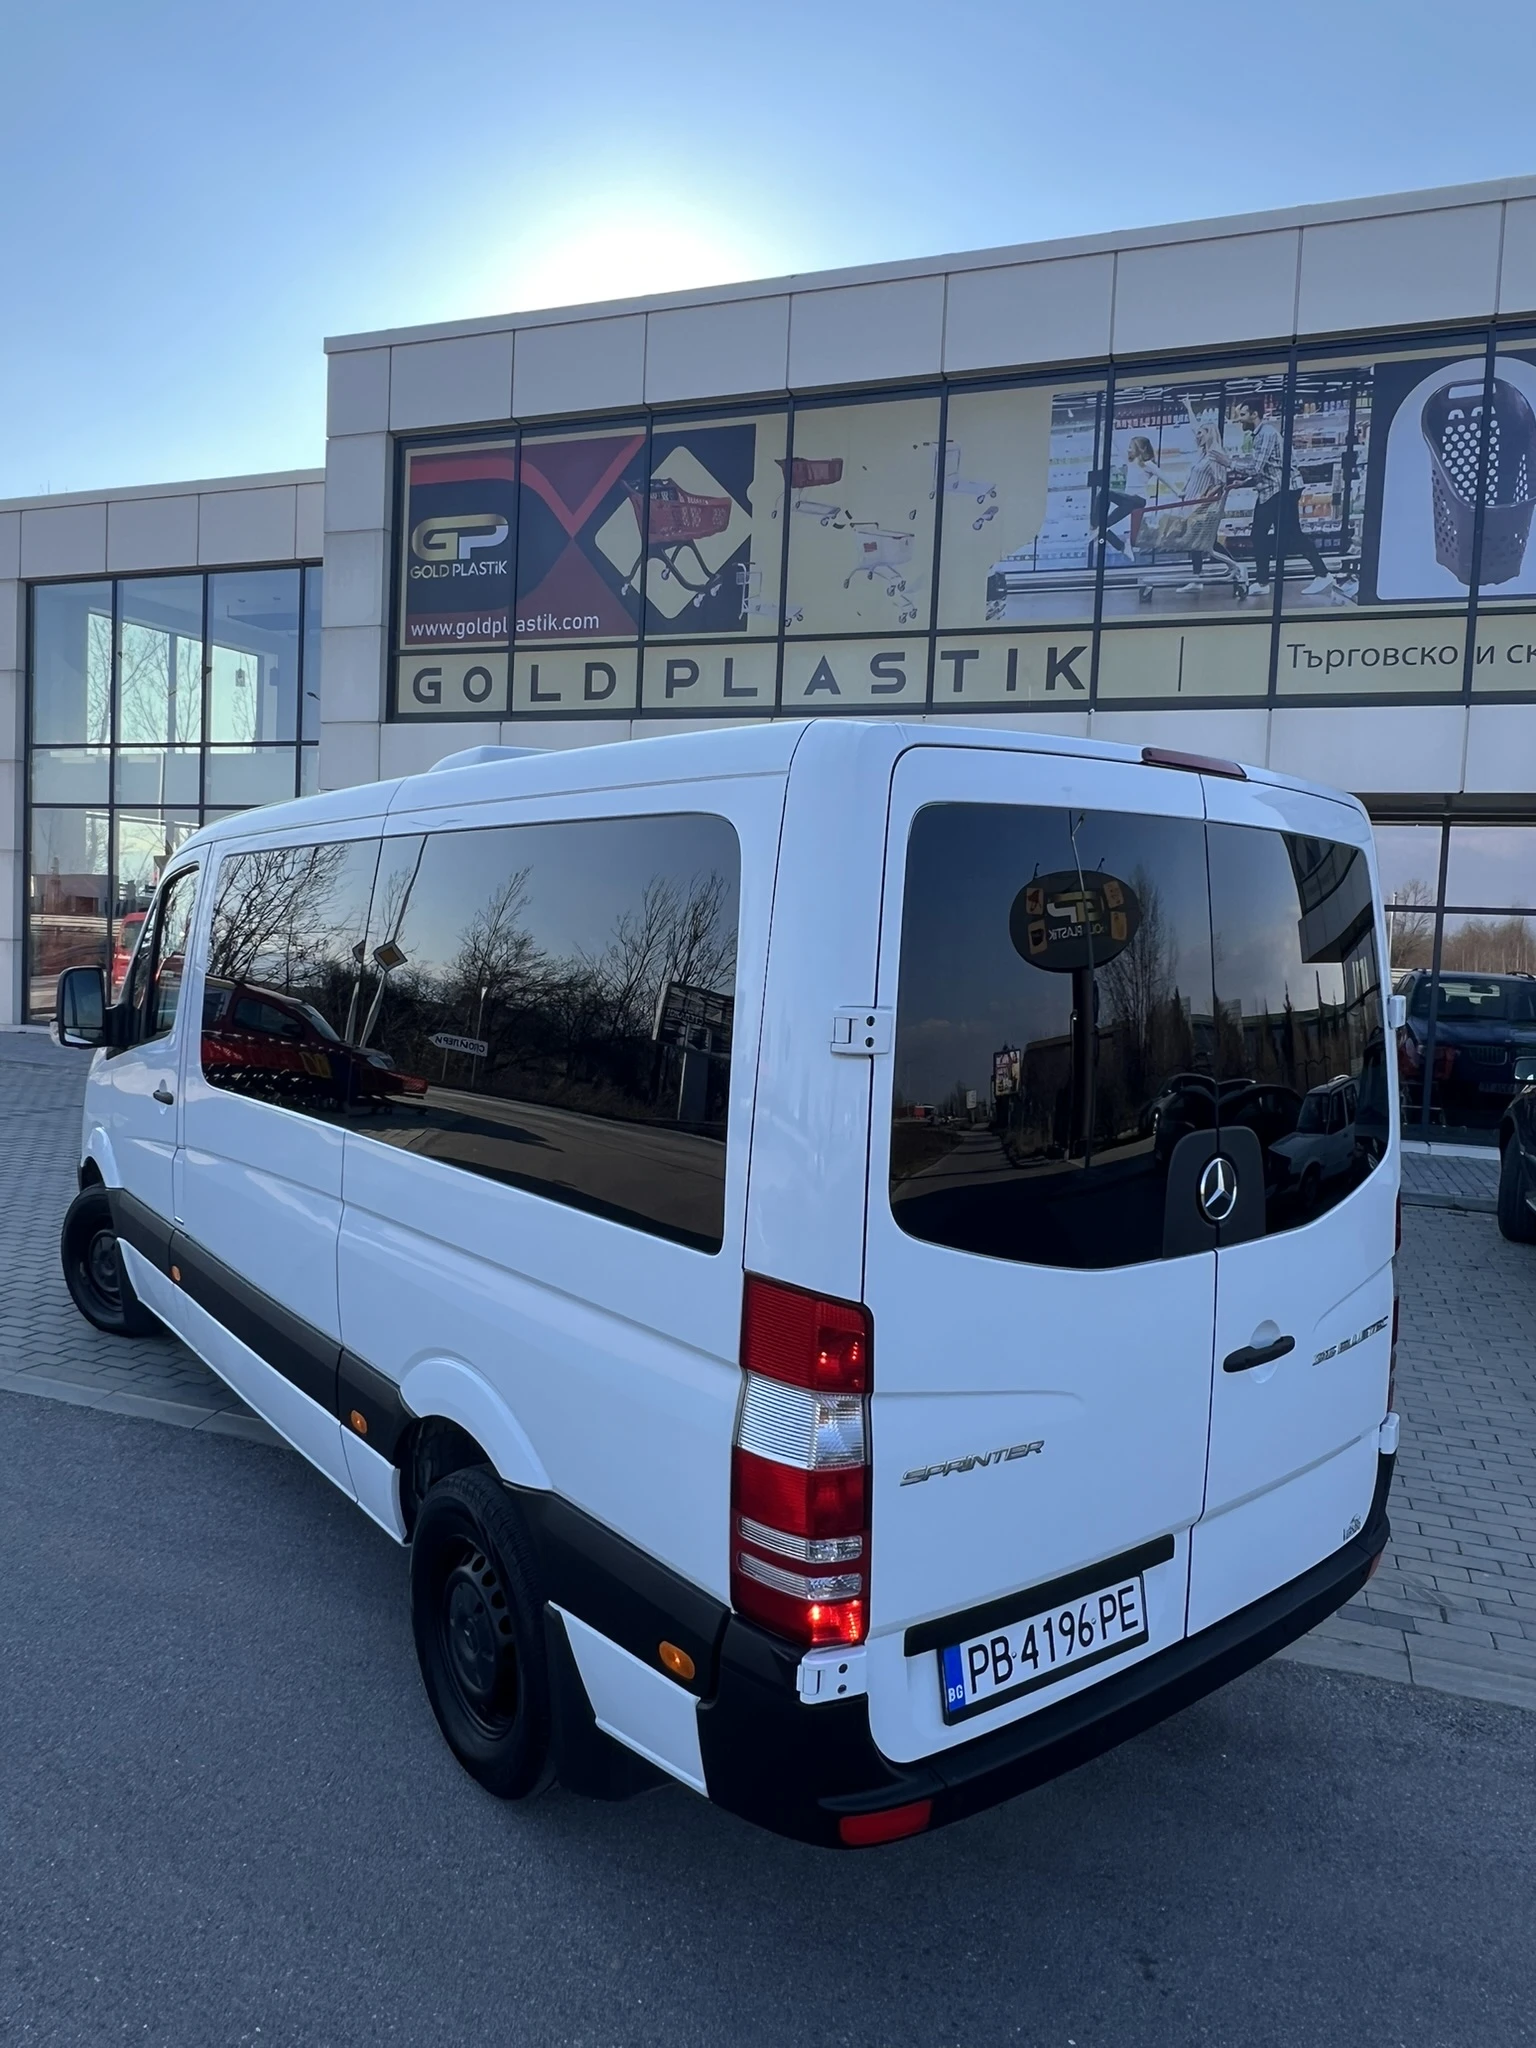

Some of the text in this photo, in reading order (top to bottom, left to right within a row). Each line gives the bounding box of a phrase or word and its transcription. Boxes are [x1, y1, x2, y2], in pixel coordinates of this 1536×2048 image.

[412, 513, 509, 562] GP
[410, 564, 450, 579] GOLD
[411, 613, 600, 640] www.goldplastik.com
[412, 646, 1088, 704] GOLD PLASTIK
[1286, 643, 1459, 675] Търговско
[1476, 645, 1495, 665] и
[900, 1440, 1045, 1486] SPRINTER
[1021, 1602, 1095, 1670] 4196
[948, 1684, 964, 1702] BG
